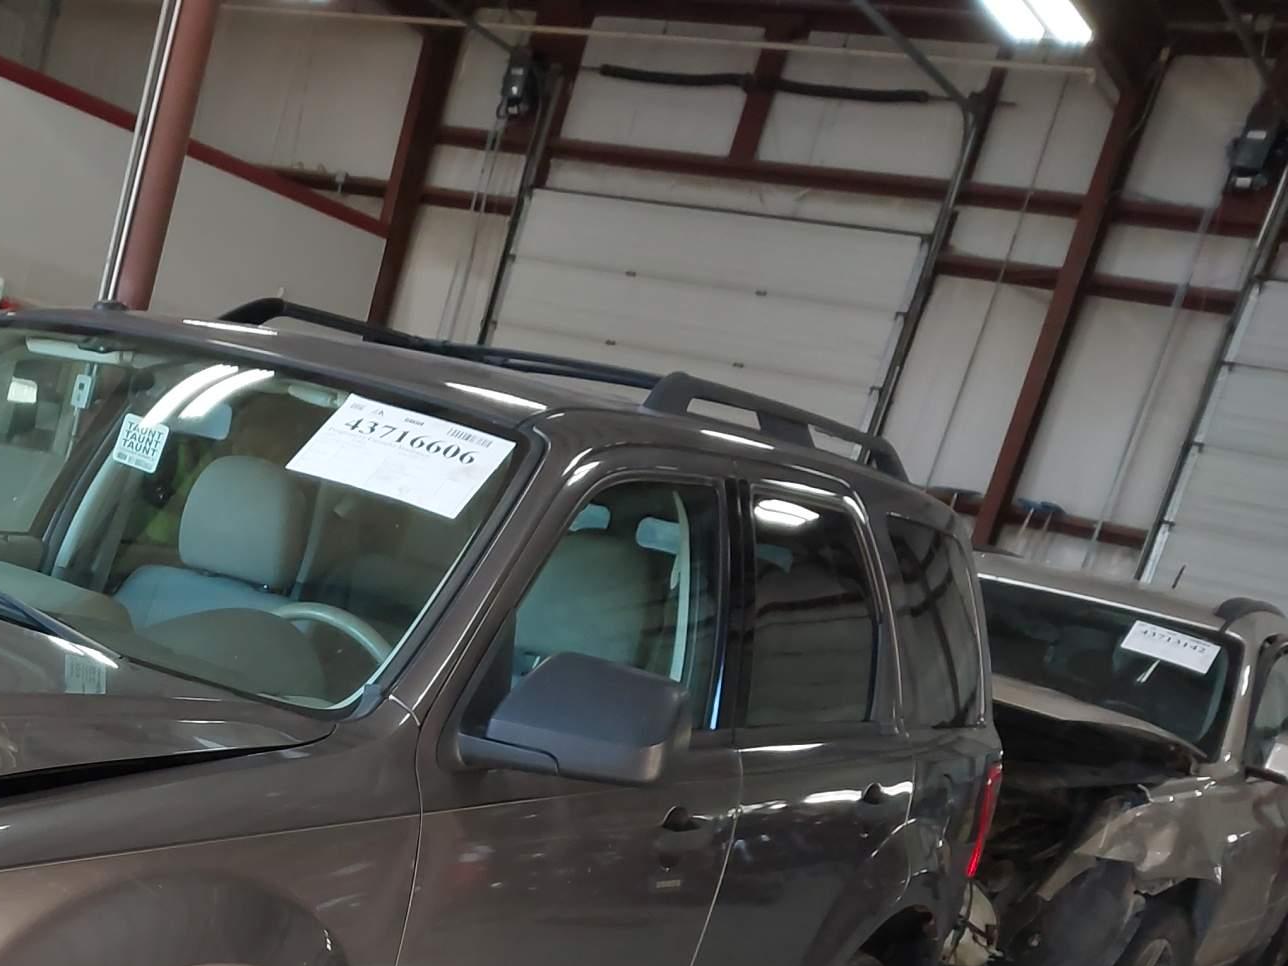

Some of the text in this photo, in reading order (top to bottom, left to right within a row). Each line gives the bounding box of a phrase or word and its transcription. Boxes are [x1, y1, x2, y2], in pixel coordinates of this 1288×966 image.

[122, 438, 157, 457] TAUNT
[125, 430, 161, 449] TAUNT
[344, 416, 481, 465] 43716606
